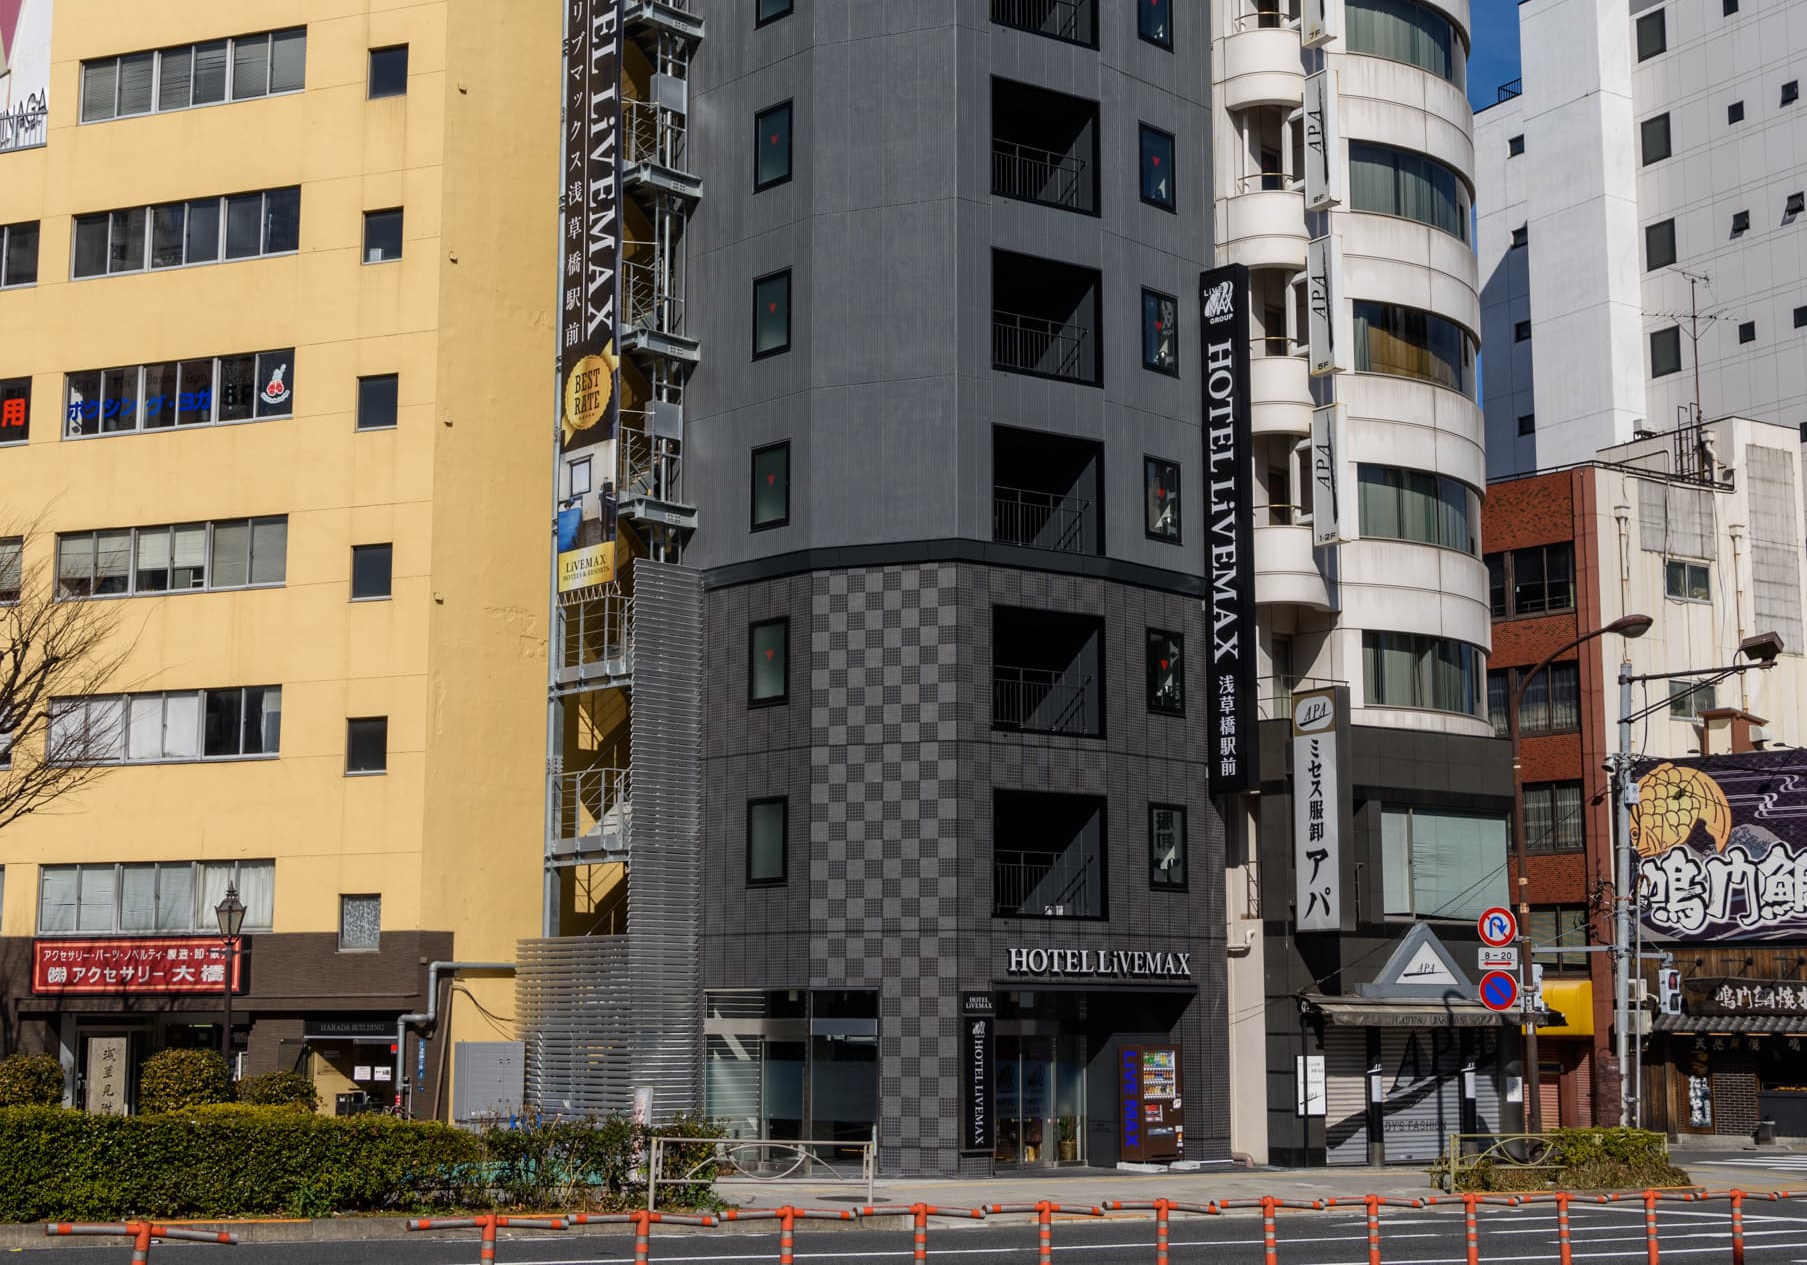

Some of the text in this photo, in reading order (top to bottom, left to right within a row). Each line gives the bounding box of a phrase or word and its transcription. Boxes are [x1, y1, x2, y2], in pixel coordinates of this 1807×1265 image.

[1307, 109, 1322, 154] APA
[1209, 292, 1234, 316] MAX
[1311, 274, 1327, 319] APA
[1210, 313, 1233, 325] GROUP
[1317, 362, 1329, 371] 5F
[575, 367, 601, 395] BEST
[574, 390, 601, 417] RATE
[1208, 338, 1234, 473] HOTEL
[1316, 443, 1331, 490] APA
[1219, 674, 1238, 777] 浅草橋駅前
[1303, 702, 1328, 722] APA
[1009, 948, 1094, 973] HOTEL
[320, 1023, 385, 1032] HARADA BUILDING
[974, 1040, 985, 1085] HOTEL
[1124, 1100, 1140, 1148] MAX
